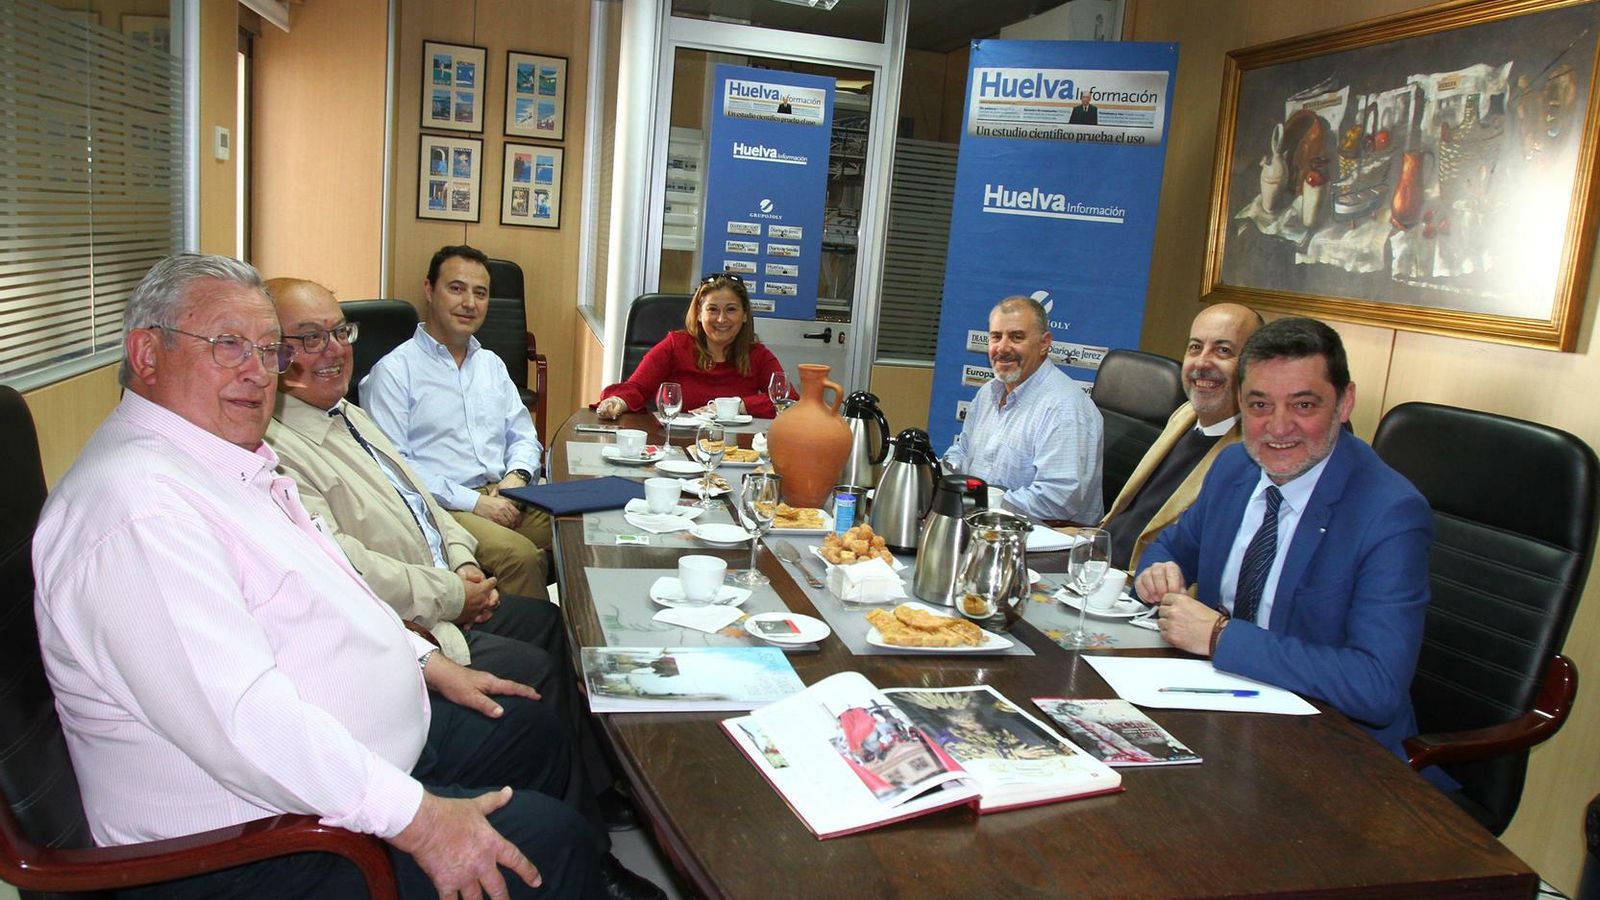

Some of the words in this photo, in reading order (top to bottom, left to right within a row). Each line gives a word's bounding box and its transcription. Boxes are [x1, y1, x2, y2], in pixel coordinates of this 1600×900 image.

[729, 81, 780, 100] Huelva
[980, 71, 1074, 100] Huelva
[976, 125, 990, 136] Un
[992, 126, 1027, 138] estudio
[1028, 127, 1075, 140] científico
[1076, 130, 1113, 143] prueba
[1114, 131, 1125, 143] el
[1126, 134, 1146, 144] uso
[734, 142, 777, 158] Huelva
[777, 153, 808, 162] Información
[983, 184, 1066, 212] Huelva
[1067, 202, 1126, 217] Información
[1048, 345, 1070, 356] Diario
[1071, 348, 1080, 357] de
[1081, 349, 1102, 360] Jerez
[966, 367, 995, 379] Europa
